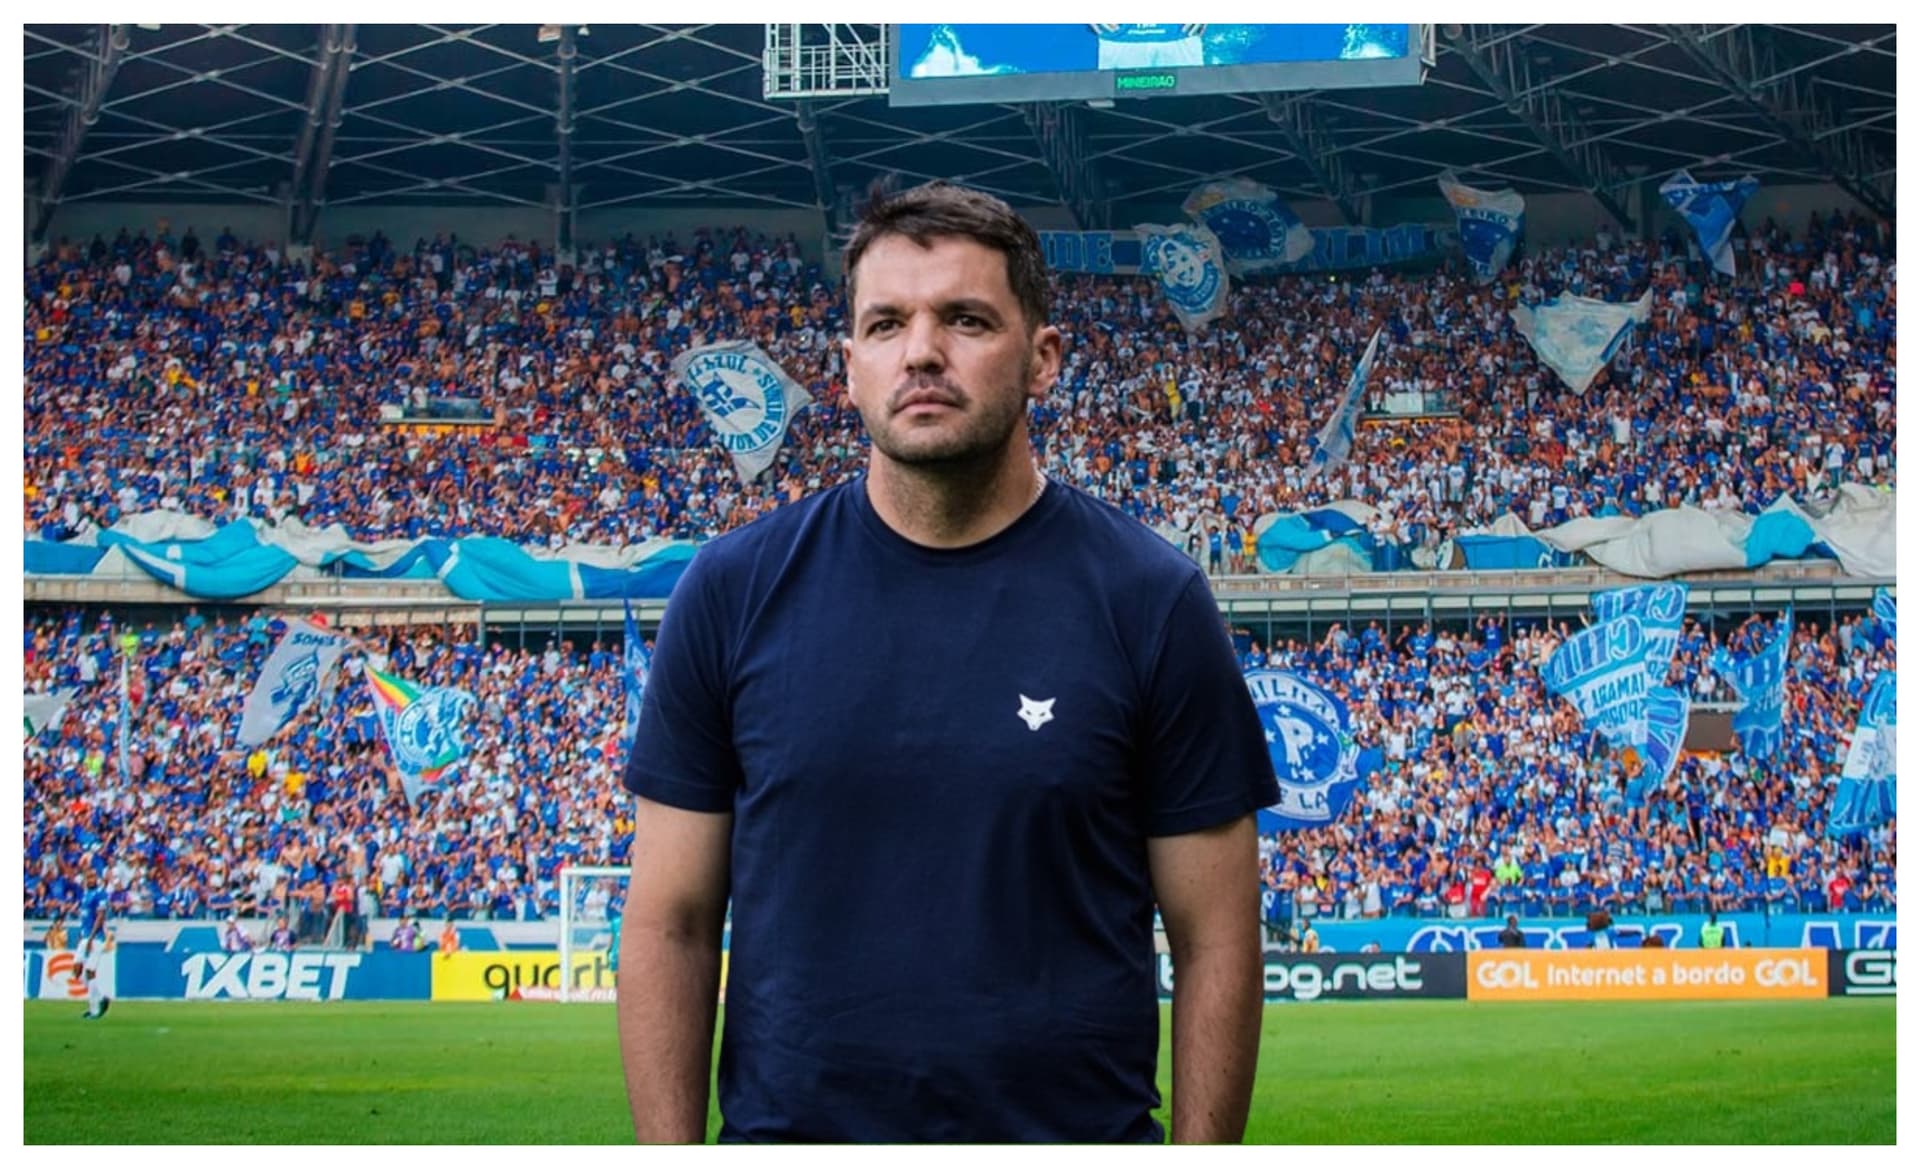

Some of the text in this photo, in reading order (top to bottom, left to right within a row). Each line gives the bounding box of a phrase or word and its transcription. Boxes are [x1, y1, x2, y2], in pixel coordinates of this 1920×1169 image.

[181, 951, 363, 1000] 1XBET
[483, 955, 619, 1001] quart
[1264, 956, 1422, 1000] og.net
[1476, 958, 1818, 989] GOL Internet a bordo GOL
[1845, 949, 1897, 984] G
